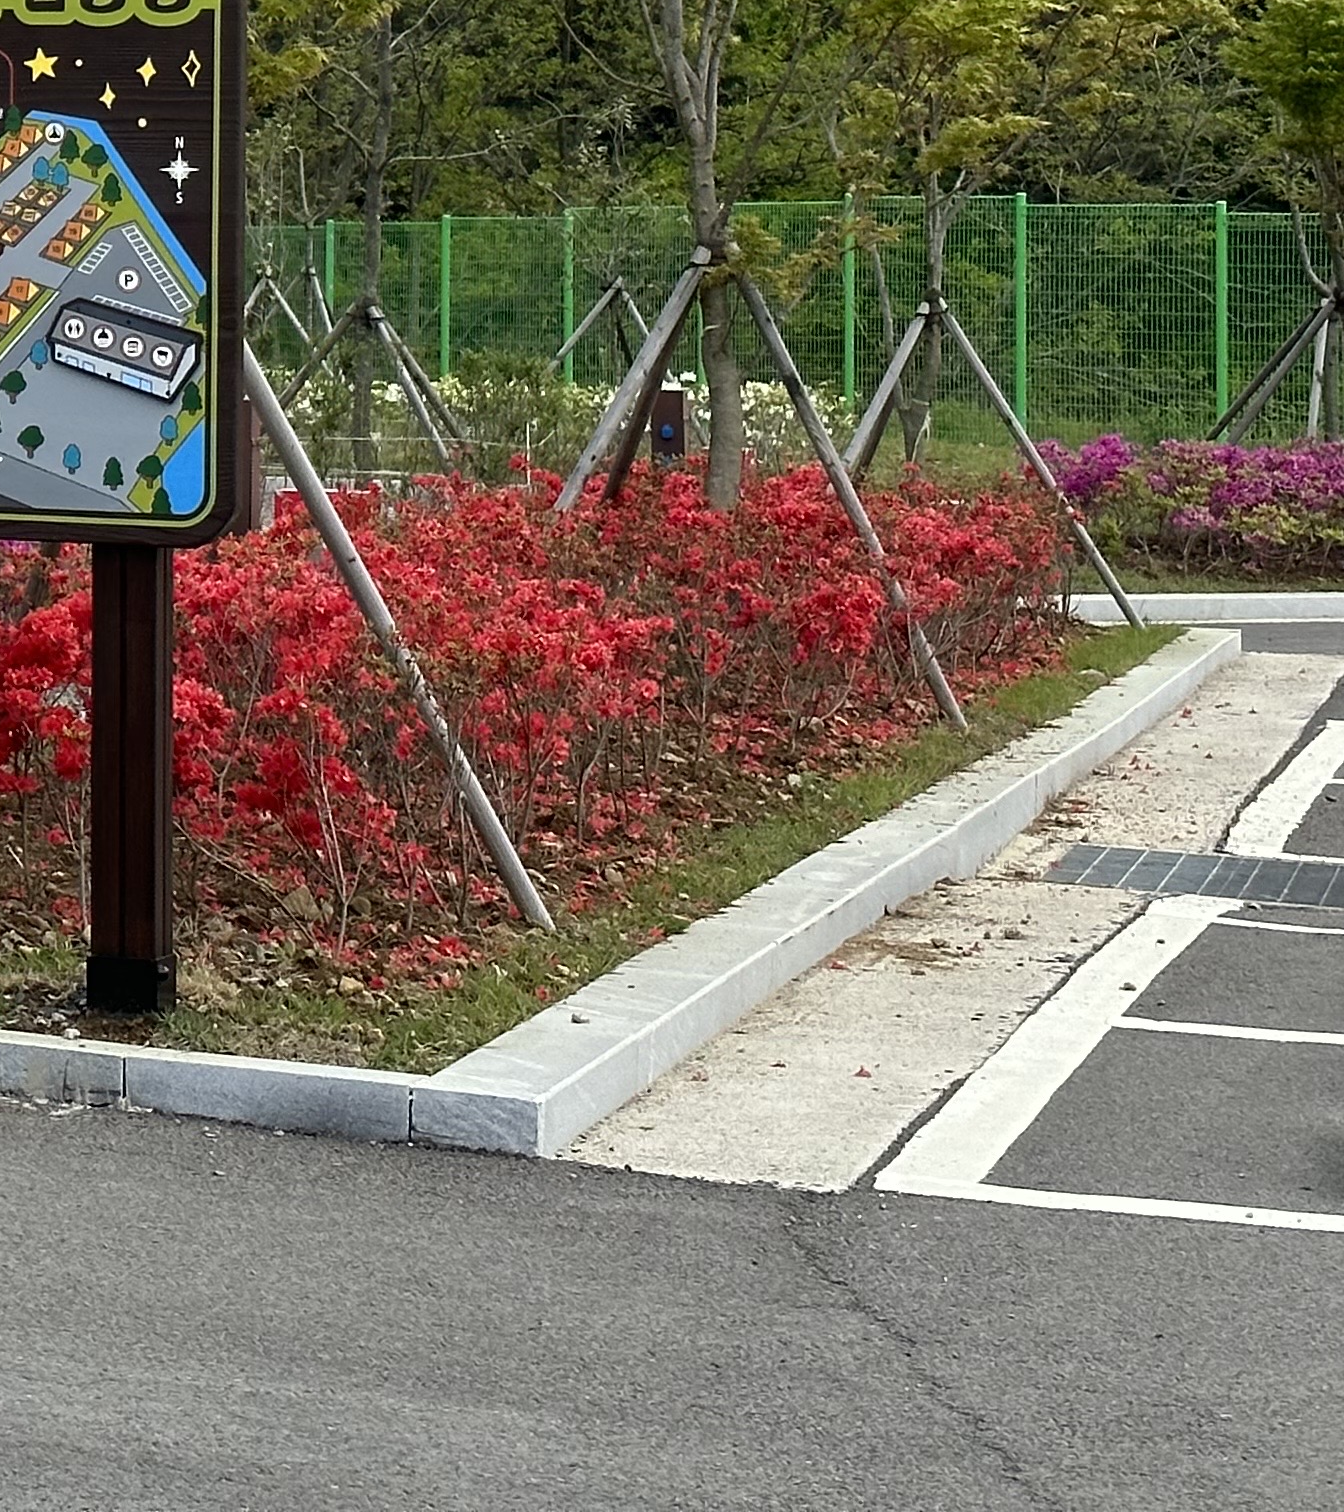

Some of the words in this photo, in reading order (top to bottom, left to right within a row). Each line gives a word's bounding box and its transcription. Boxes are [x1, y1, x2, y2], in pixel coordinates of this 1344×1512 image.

[175, 136, 184, 149] N
[175, 191, 184, 204] S
[125, 274, 133, 287] P
